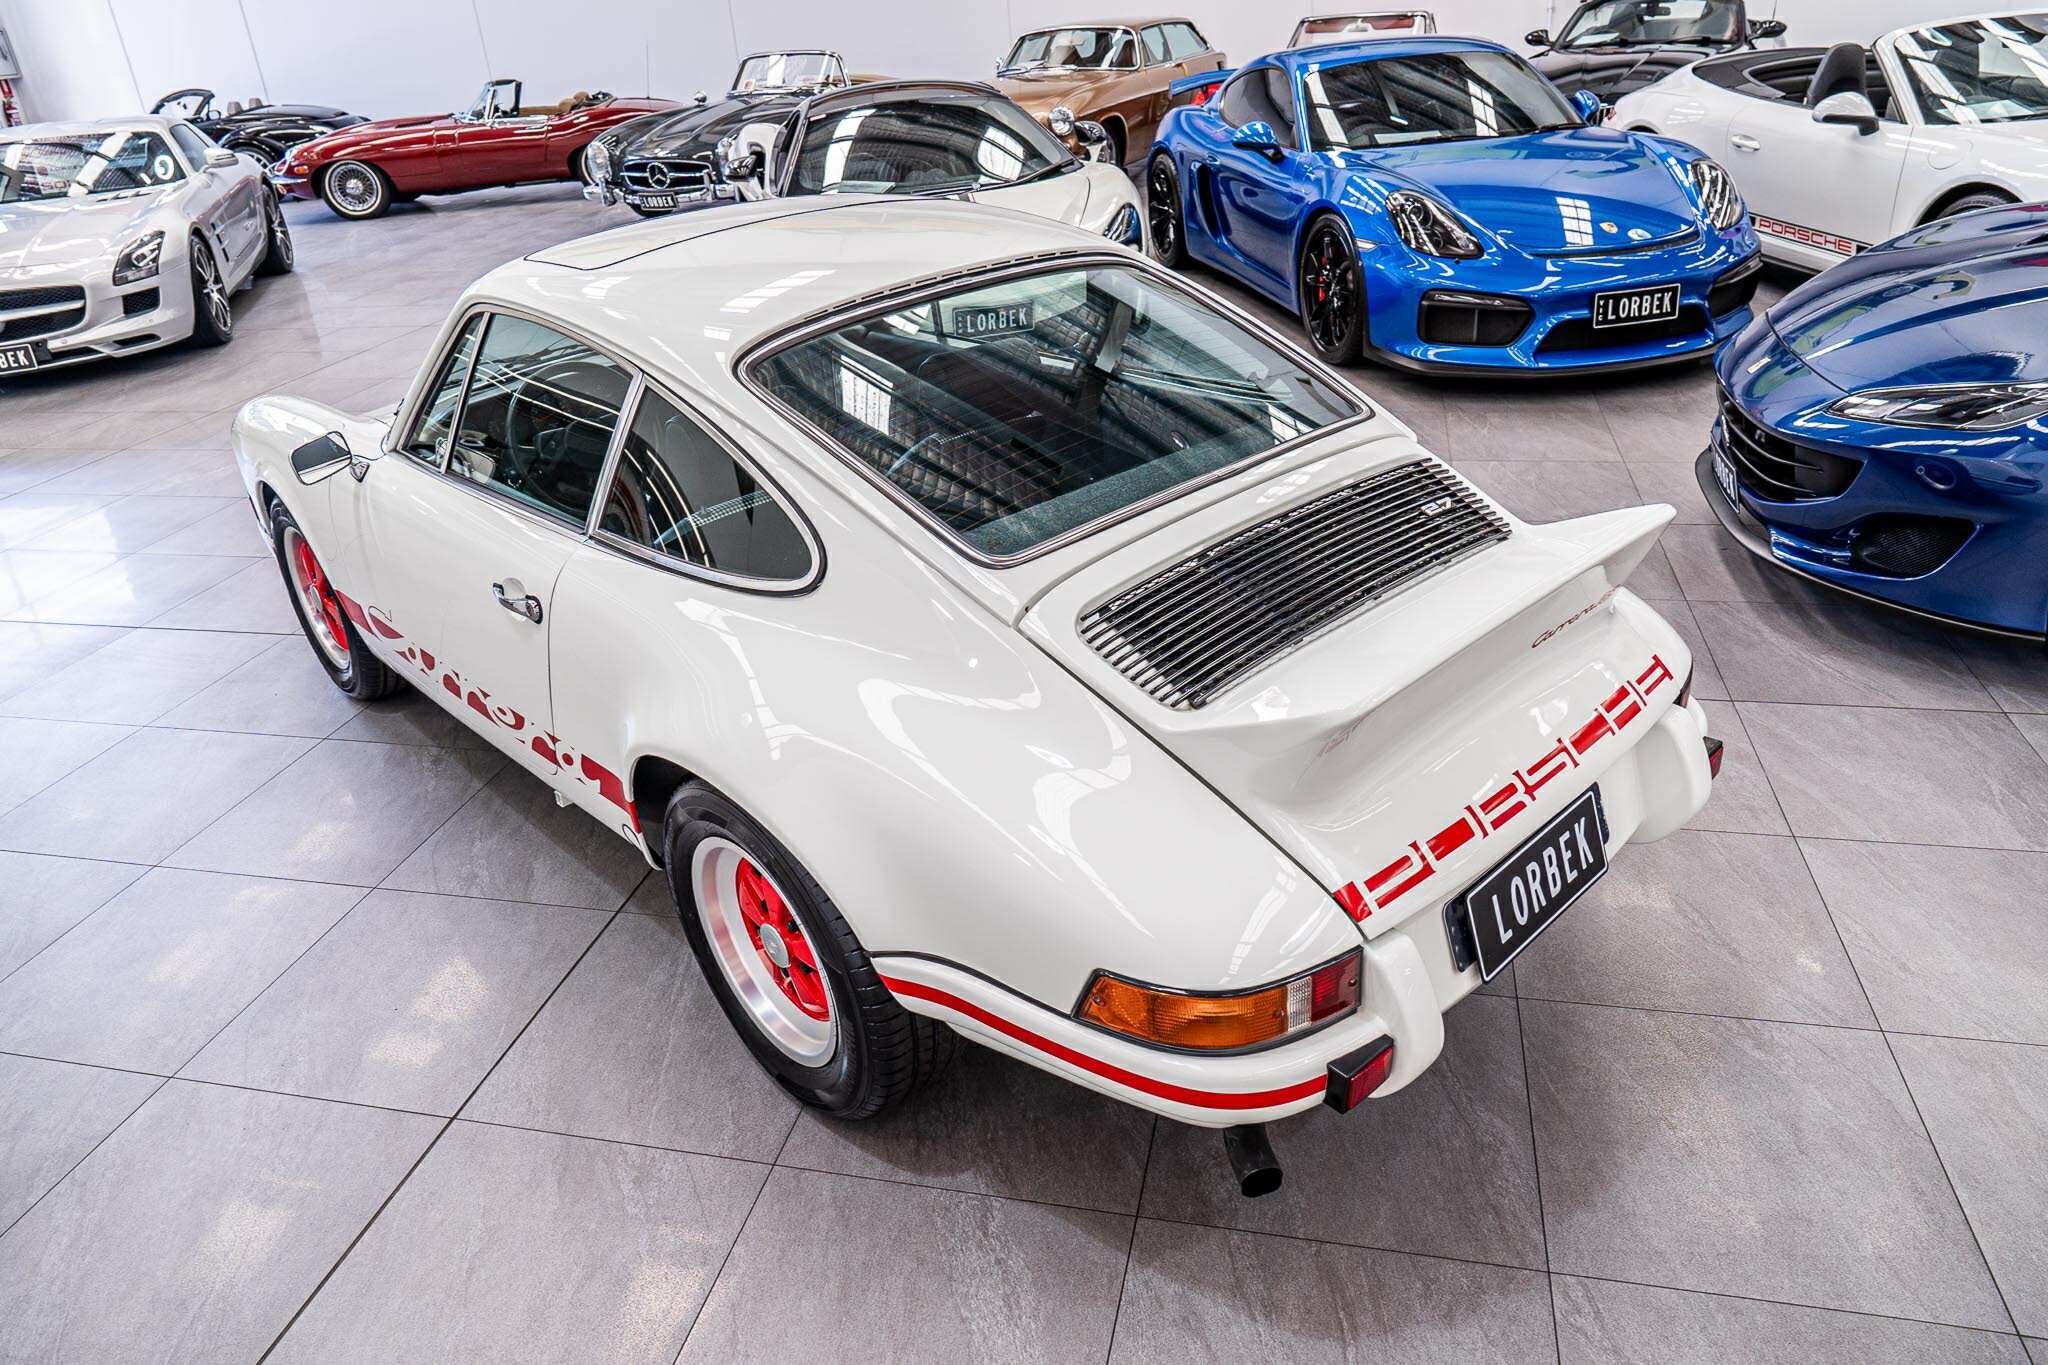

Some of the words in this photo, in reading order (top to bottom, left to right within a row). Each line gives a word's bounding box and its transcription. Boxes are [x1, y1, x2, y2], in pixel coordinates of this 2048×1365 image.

[643, 196, 674, 207] LORBEK
[1759, 218, 1852, 253] PORSCHE
[966, 307, 1028, 333] LORBEK
[1607, 291, 1673, 320] LORBEK
[366, 603, 603, 788] Carrera
[1348, 655, 1673, 916] PORSCHE
[1491, 816, 1594, 945] LORBEK
